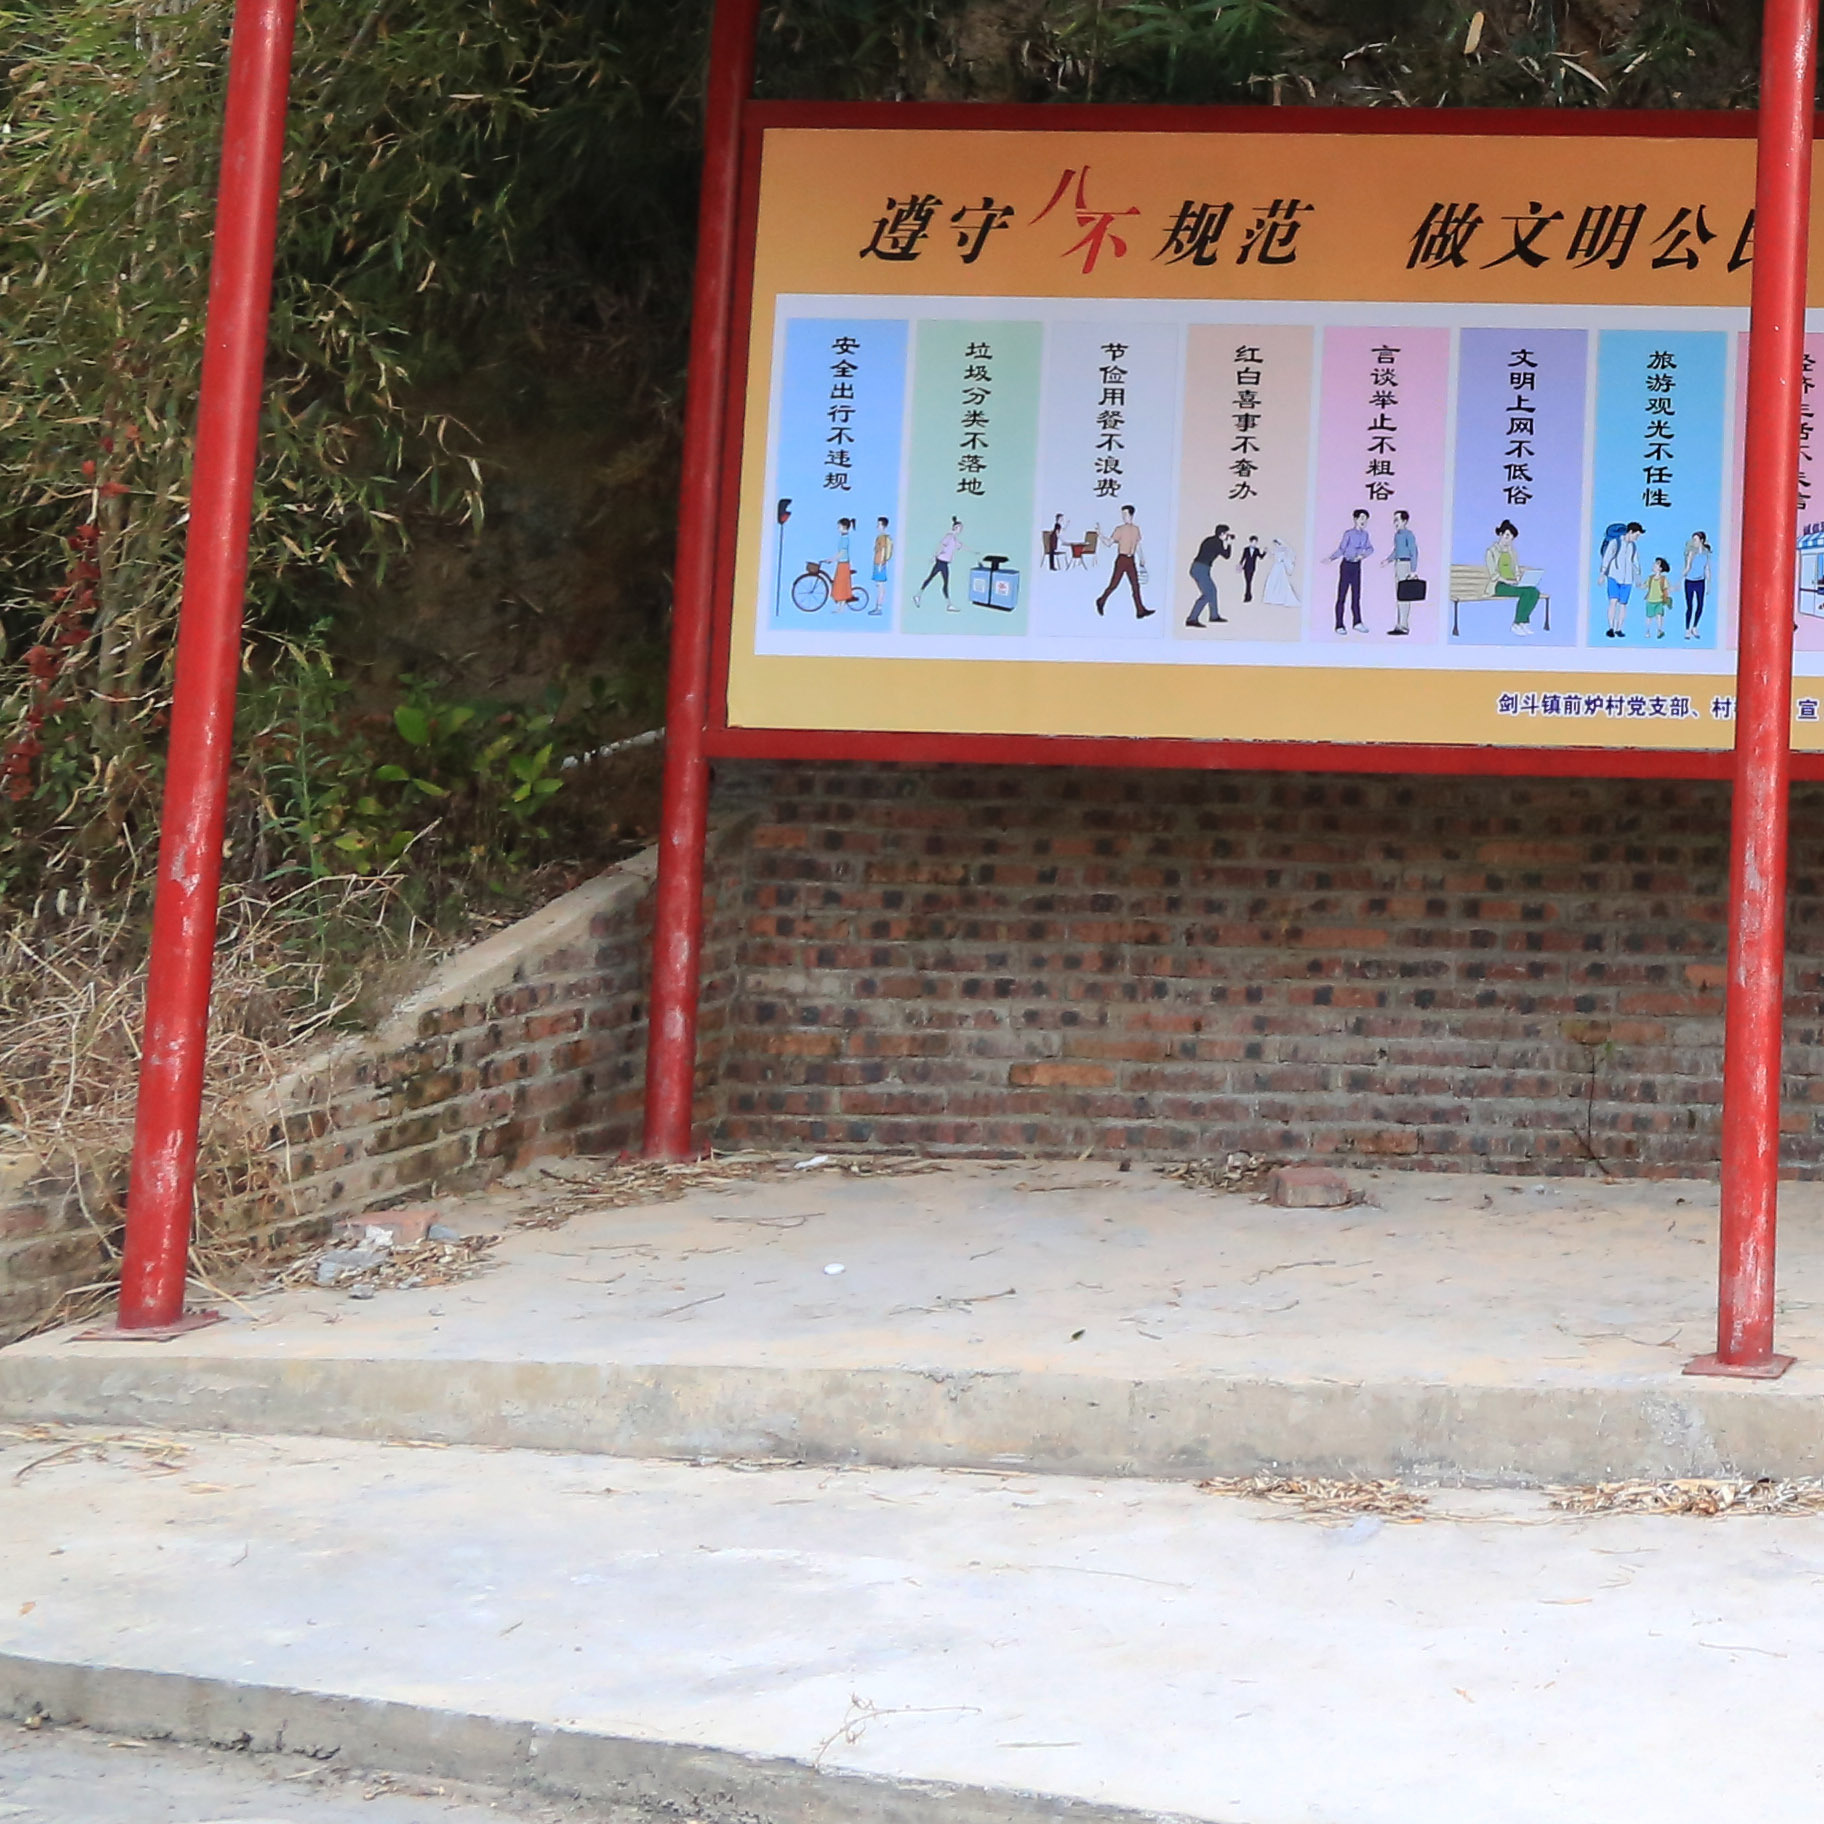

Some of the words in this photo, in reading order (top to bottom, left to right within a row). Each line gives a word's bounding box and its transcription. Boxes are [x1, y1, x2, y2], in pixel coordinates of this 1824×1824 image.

[823, 337, 860, 491] 安全出行不违规
[956, 342, 993, 496] 垃圾分类不落地
[1094, 343, 1128, 498] 节俭用餐不浪费
[1228, 345, 1264, 500] 红白喜事不奢办
[1365, 345, 1401, 501] 言谈举止不粗俗
[1503, 349, 1538, 505] 文明上网不低俗
[1642, 351, 1677, 507] 旅游观光不任性
